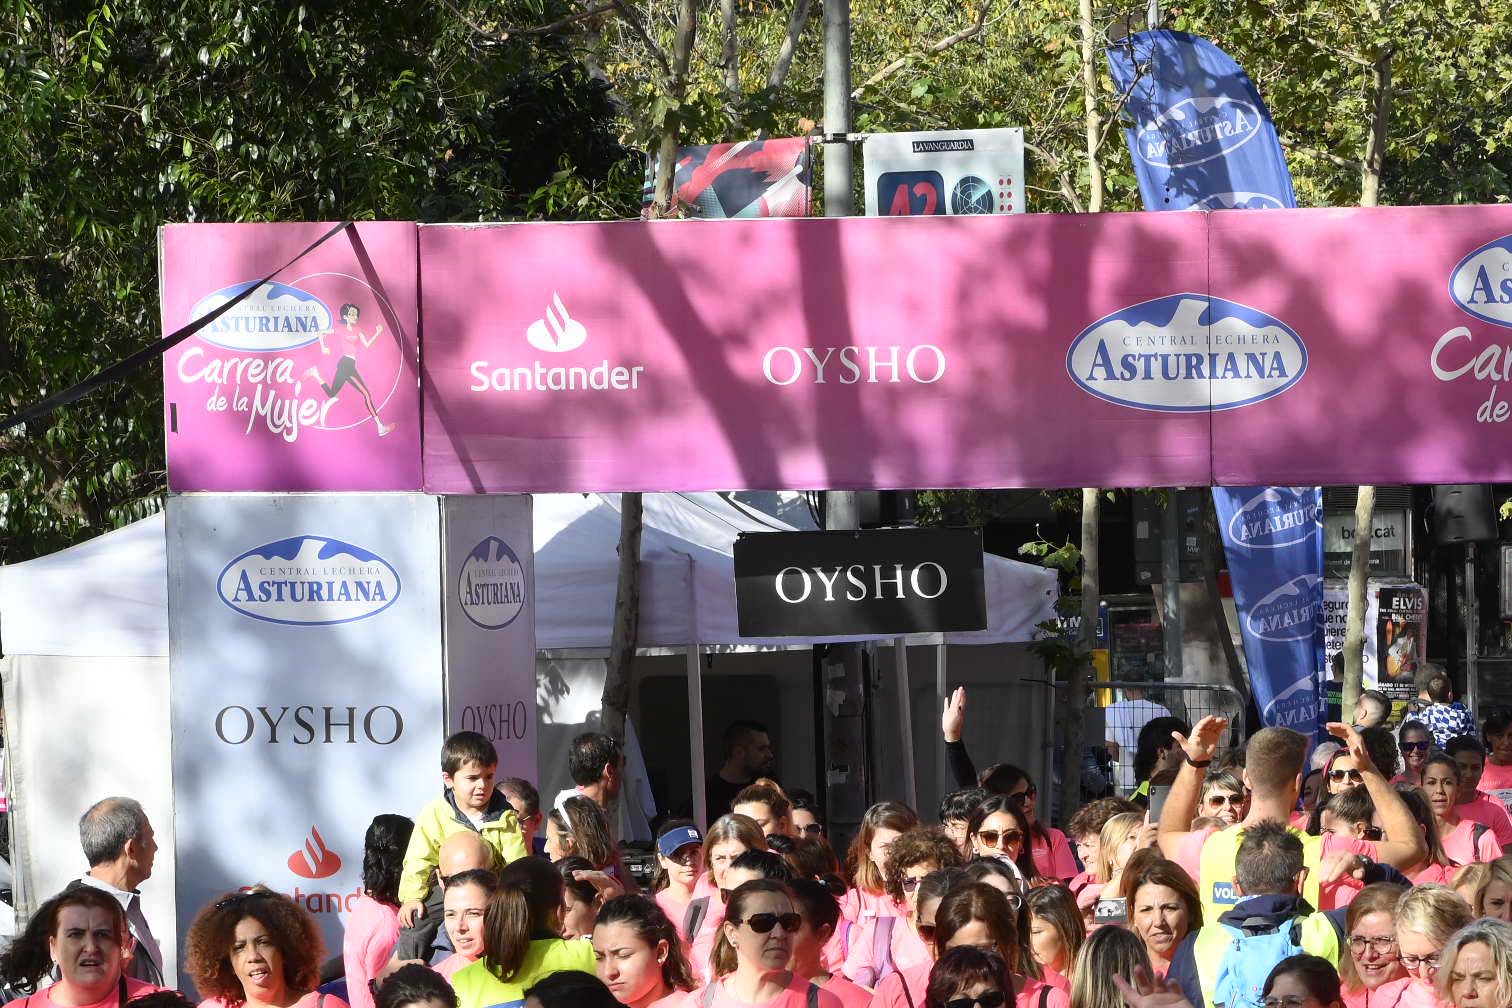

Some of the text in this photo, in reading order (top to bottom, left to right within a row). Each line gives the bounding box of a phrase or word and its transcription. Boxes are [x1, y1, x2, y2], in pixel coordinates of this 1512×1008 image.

[914, 139, 973, 152] LA VANGUARDIA
[1122, 333, 1281, 347] CENTRAL LECHERA
[176, 346, 296, 385] Carrera
[469, 359, 644, 392] Santander
[761, 344, 947, 386] OYSHO
[1085, 338, 1290, 382] ASTURIANA
[206, 380, 340, 442] de la Mujer
[1475, 384, 1511, 424] de
[231, 568, 388, 603] ASTURIANA
[258, 566, 382, 577] CENTRAL LECHERA
[463, 570, 523, 607] ASTURIANA
[775, 561, 948, 604] OYSHO
[1391, 597, 1424, 610] ELVIS
[214, 704, 405, 746] OYSHO
[460, 699, 528, 743] OYSHO
